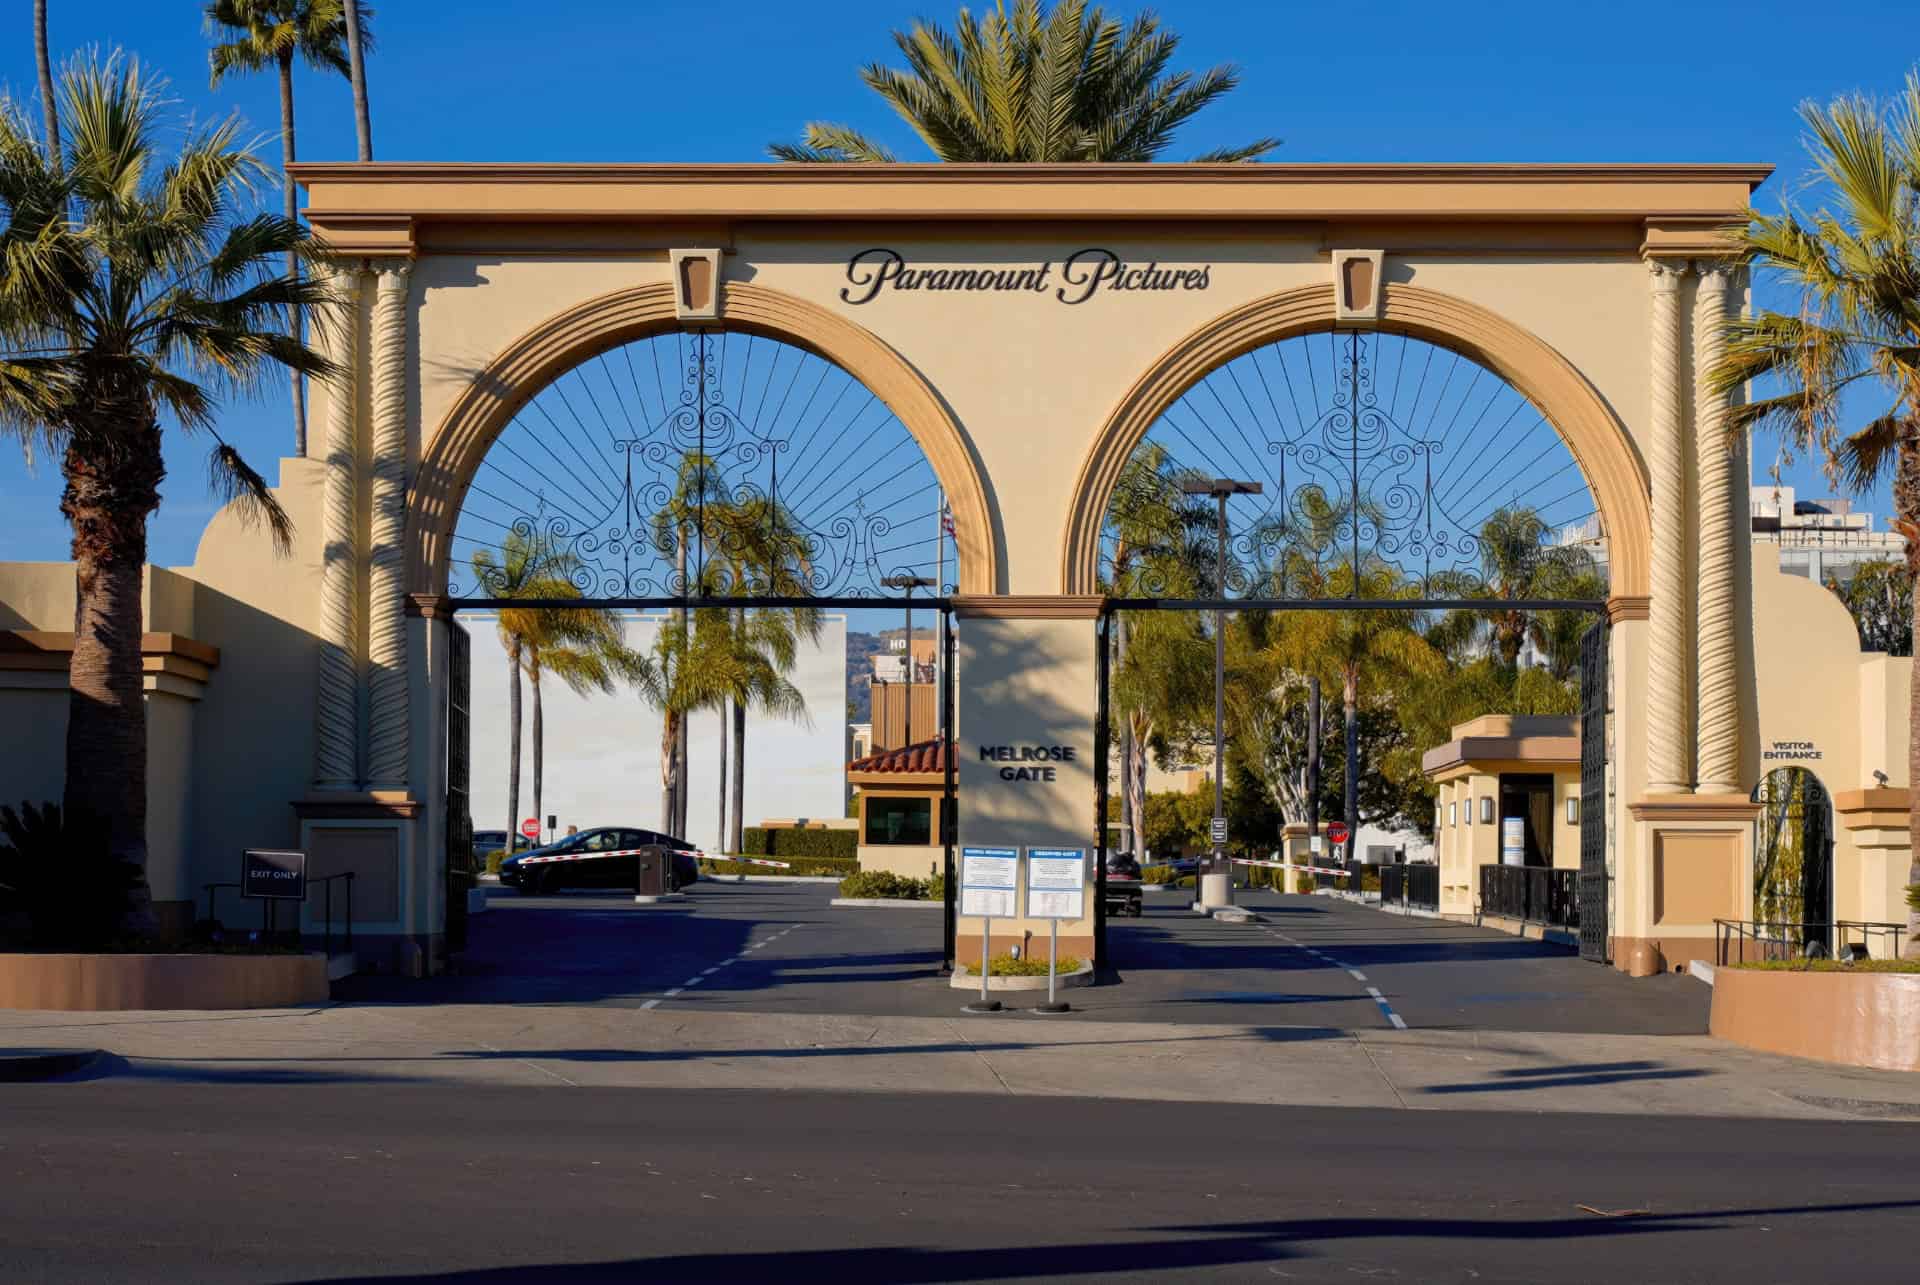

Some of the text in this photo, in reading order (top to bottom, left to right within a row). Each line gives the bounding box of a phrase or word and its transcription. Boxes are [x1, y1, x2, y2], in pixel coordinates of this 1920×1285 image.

[840, 248, 1211, 304] Paramount Pictures
[1772, 742, 1814, 750] VISITOR
[979, 745, 1075, 761] MELROSE
[1764, 751, 1823, 759] ENTRANCE
[1000, 766, 1057, 781] GATE
[251, 870, 298, 879] EXIT ONLY
